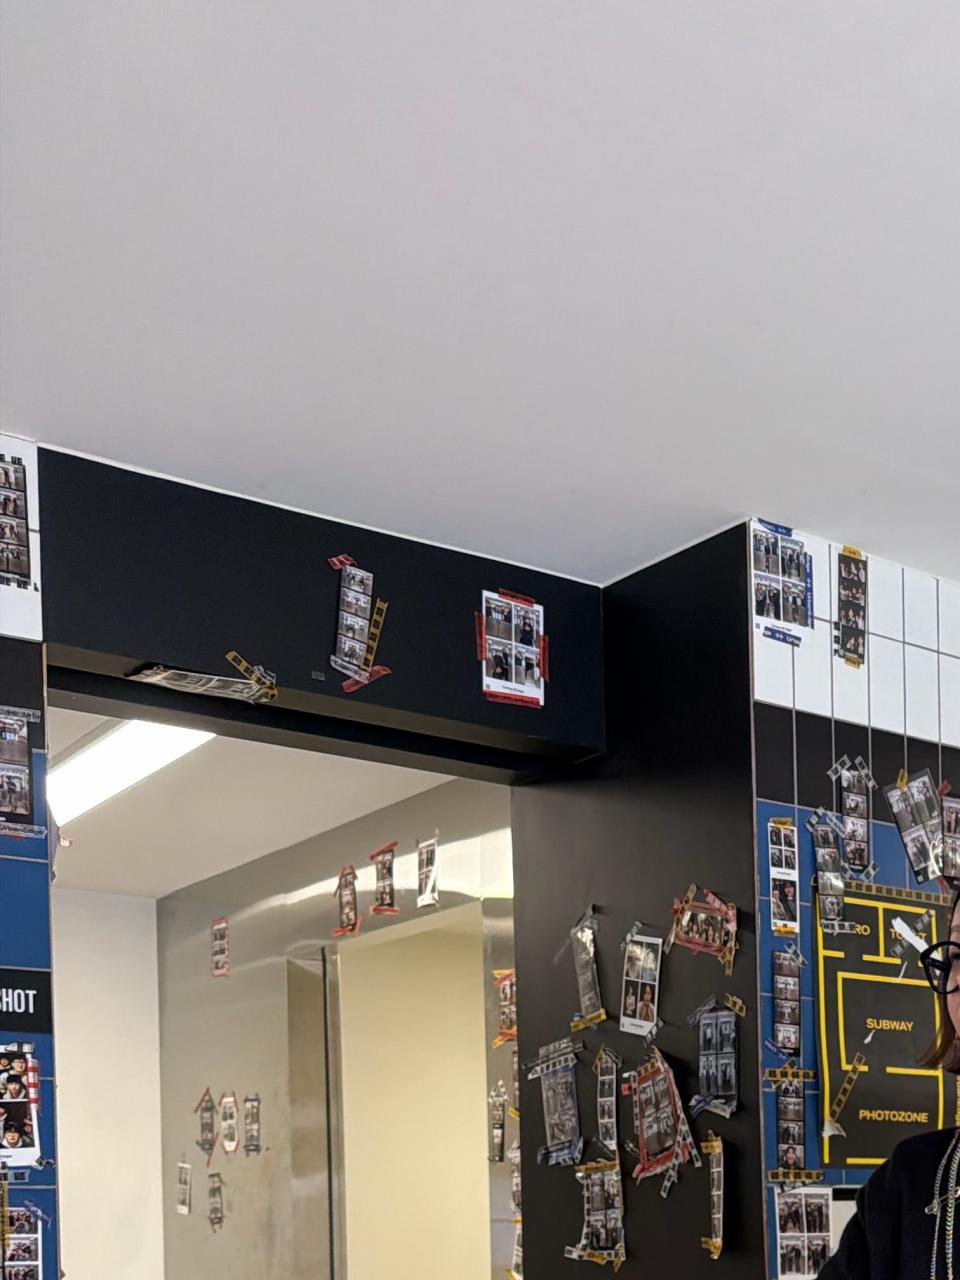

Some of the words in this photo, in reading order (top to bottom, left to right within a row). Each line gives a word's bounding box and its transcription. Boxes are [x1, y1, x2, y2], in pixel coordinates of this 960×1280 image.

[0, 987, 37, 1013] HOT
[866, 1018, 913, 1031] SUBWAY
[859, 1109, 928, 1122] PHOTOZONE
